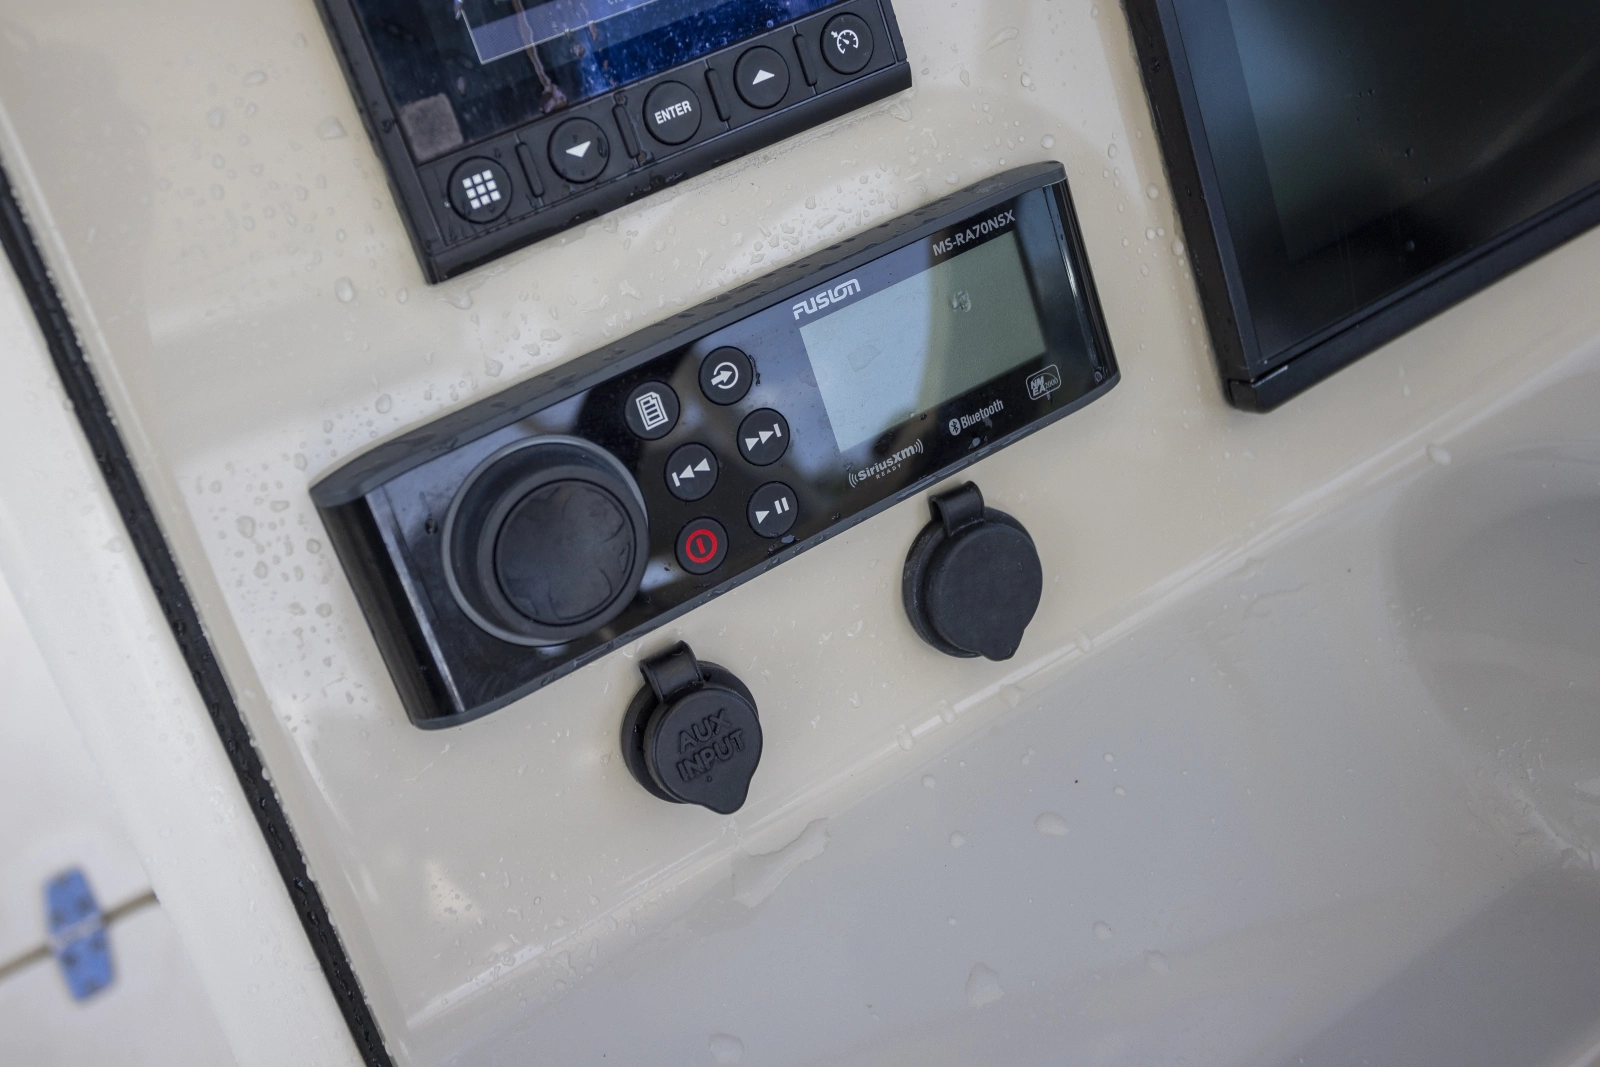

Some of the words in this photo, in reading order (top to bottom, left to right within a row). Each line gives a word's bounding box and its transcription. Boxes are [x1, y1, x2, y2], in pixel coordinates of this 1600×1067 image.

[654, 100, 692, 125] ENTER
[932, 209, 1016, 257] MS-RA70NSX
[792, 278, 861, 320] FUSION
[960, 399, 1004, 430] Bluetooth
[678, 708, 731, 754] AUX
[676, 728, 744, 782] INPUT
